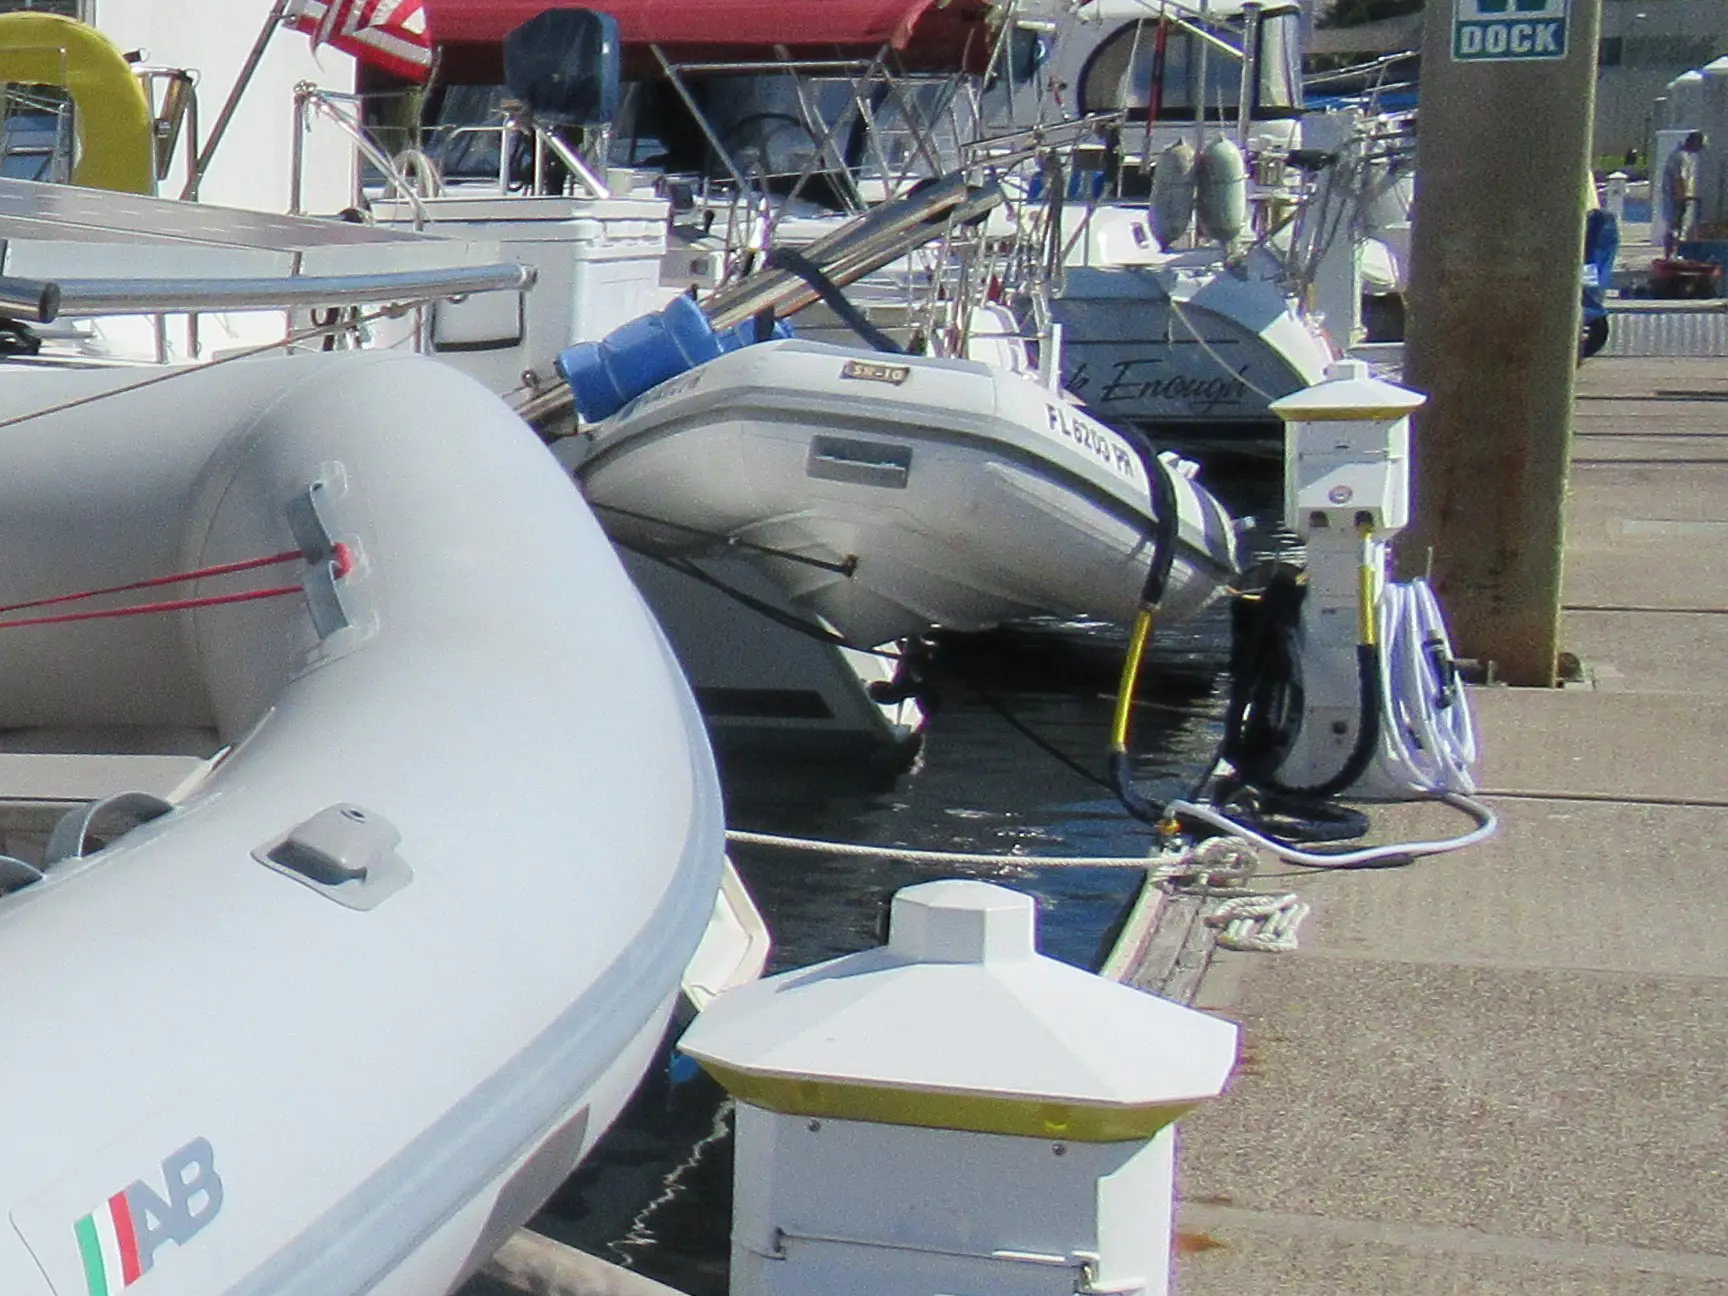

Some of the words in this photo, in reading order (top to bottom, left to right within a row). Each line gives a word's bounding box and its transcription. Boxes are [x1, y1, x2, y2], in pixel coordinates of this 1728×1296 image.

[1459, 21, 1561, 55] DOCK
[1101, 358, 1250, 413] Enough
[122, 1135, 225, 1277] AB
